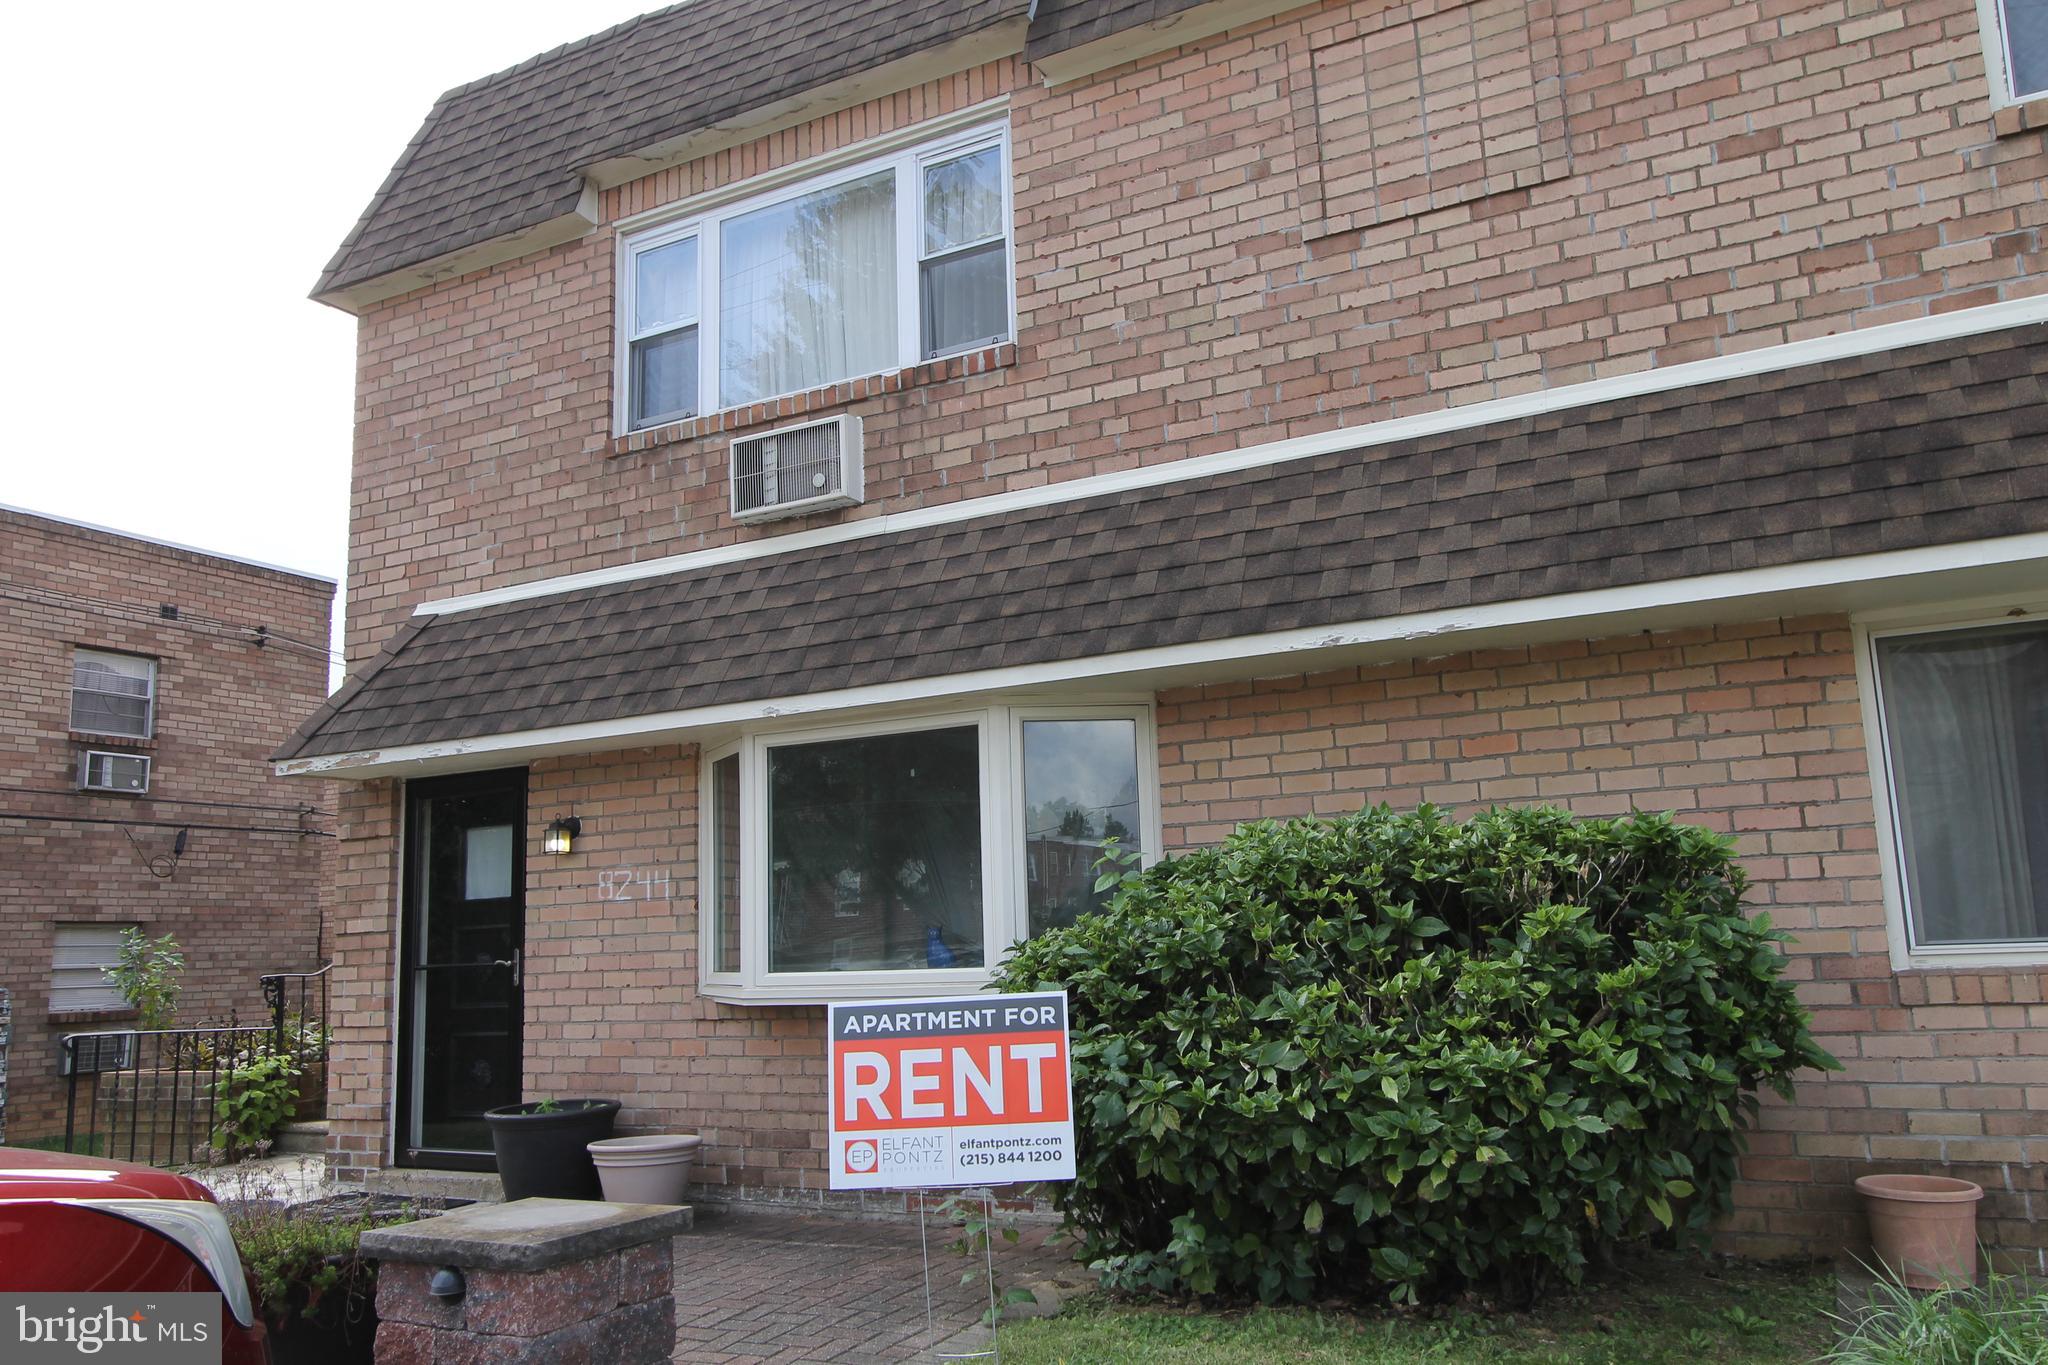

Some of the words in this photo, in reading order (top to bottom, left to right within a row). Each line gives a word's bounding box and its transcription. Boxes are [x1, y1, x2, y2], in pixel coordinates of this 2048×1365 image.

[598, 869, 670, 901] 8244
[843, 1009, 996, 1034] APARTMENT
[1004, 1006, 1056, 1027] FOR
[843, 1043, 1057, 1121] RENT
[882, 1135, 944, 1151] ELFANT
[959, 1136, 1062, 1151] elfantpontz.com
[852, 1149, 873, 1164] EP
[882, 1150, 943, 1165] PONTZ
[960, 1152, 994, 1167] (215)
[998, 1152, 1025, 1164] 844
[1028, 1150, 1062, 1162] 1200
